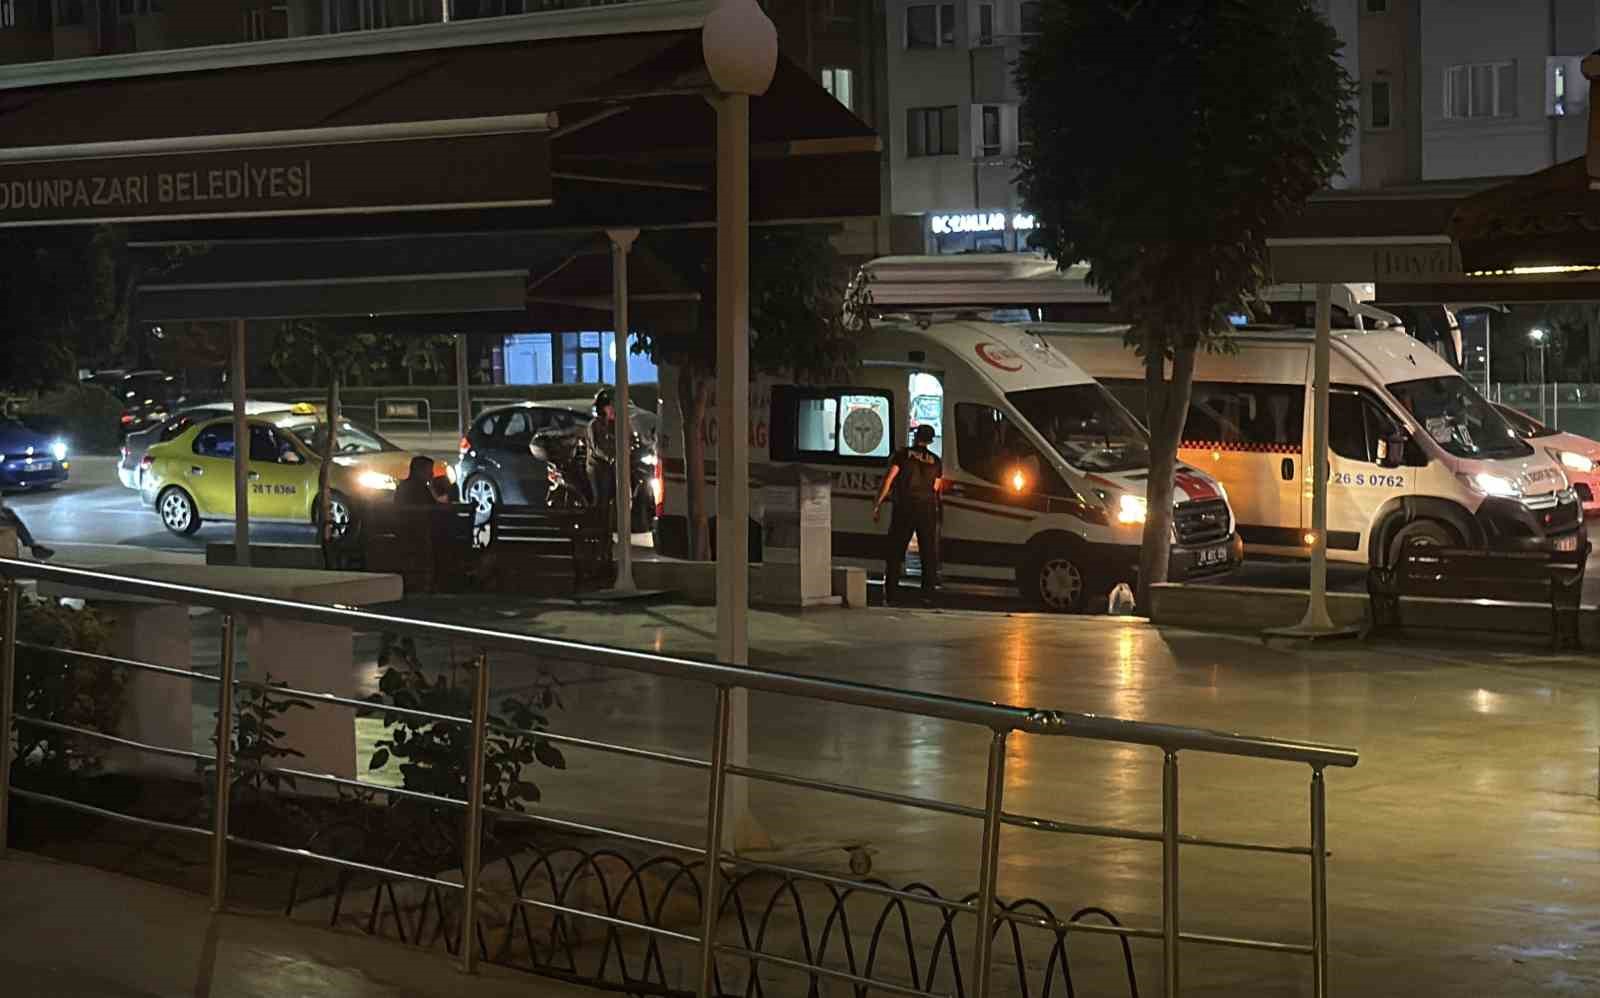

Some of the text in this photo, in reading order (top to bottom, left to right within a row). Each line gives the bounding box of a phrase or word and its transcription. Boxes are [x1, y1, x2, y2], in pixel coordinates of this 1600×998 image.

[158, 160, 311, 202] BELEDİYESİ
[1335, 472, 1404, 488] 26 S 0762
